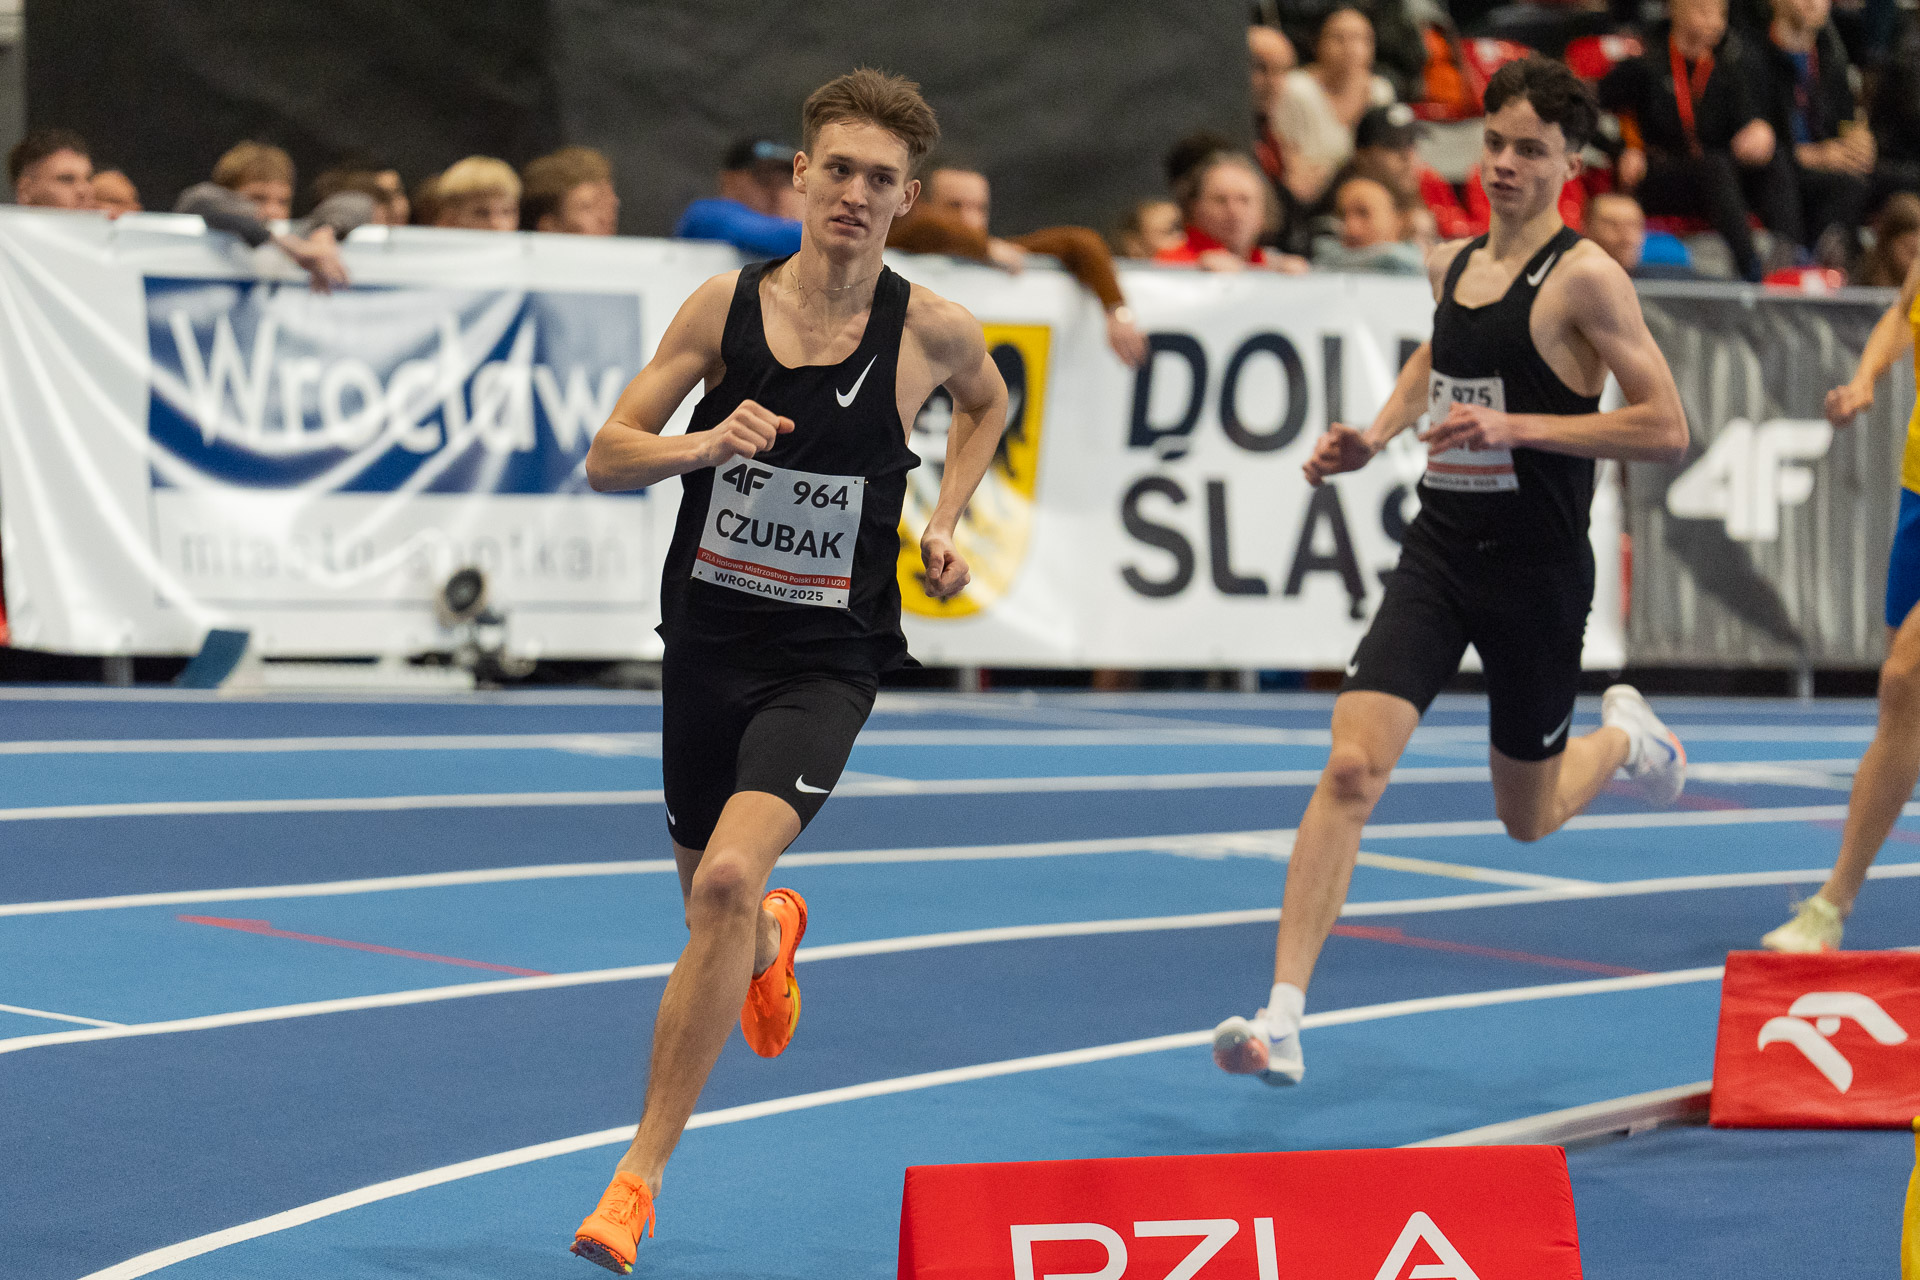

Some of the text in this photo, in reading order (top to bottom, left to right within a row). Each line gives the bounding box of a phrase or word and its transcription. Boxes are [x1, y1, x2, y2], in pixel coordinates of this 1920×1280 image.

[1129, 332, 1428, 452] DOL
[1451, 386, 1493, 408] 975
[722, 463, 849, 511] 4F 964
[1667, 416, 1834, 542] 4F
[716, 508, 845, 559] CZUBAK
[701, 551, 716, 563] PZLA
[717, 557, 744, 570] Halowe
[745, 564, 788, 581] Mistrzostwa
[789, 575, 811, 585] Polski
[831, 579, 847, 587] U20
[714, 571, 824, 602] WROCŁAW 2025
